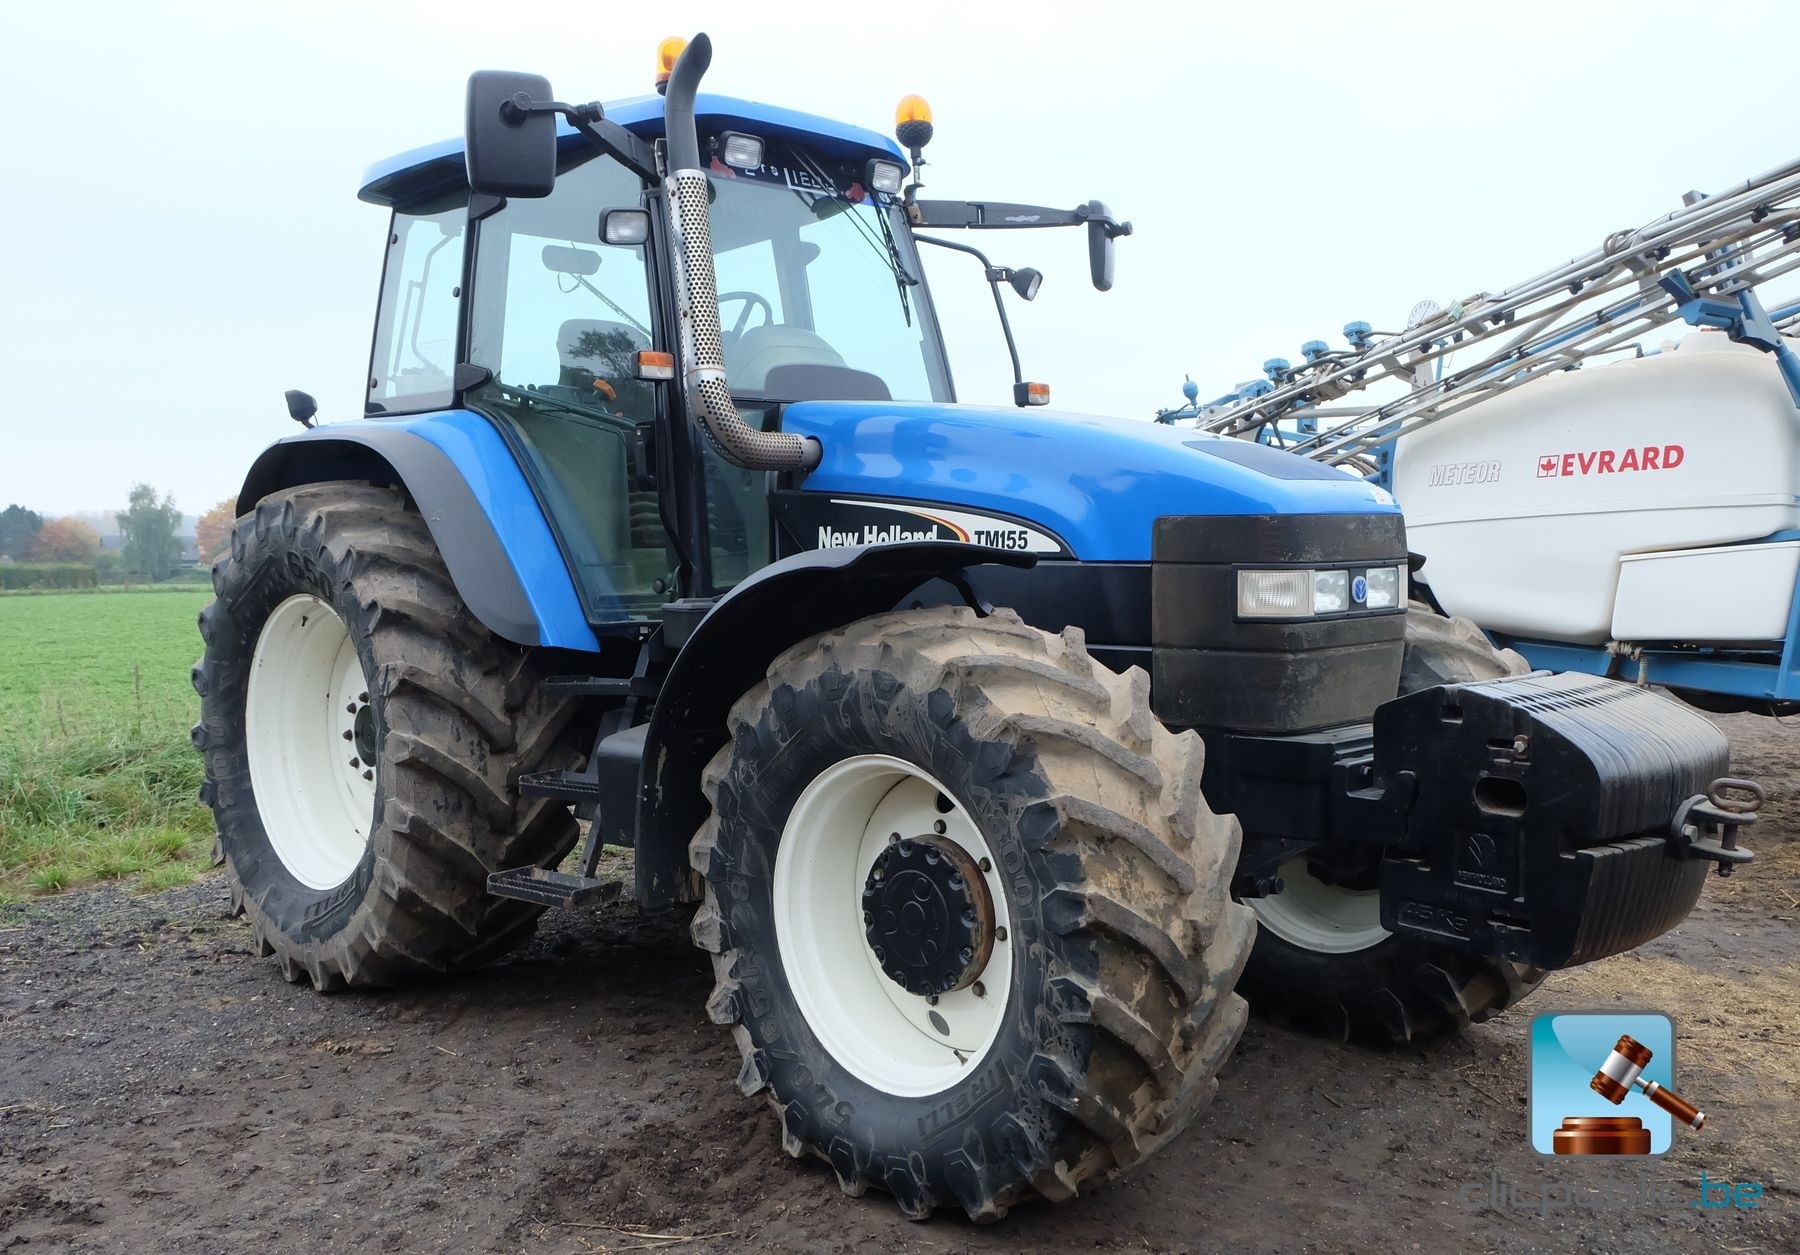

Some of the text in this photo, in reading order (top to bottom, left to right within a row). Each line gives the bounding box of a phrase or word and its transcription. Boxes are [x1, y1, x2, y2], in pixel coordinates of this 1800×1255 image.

[1561, 445, 1685, 476] EVRARD
[1428, 460, 1502, 487] METEOR
[818, 526, 858, 550] New
[974, 529, 1029, 550] TM155
